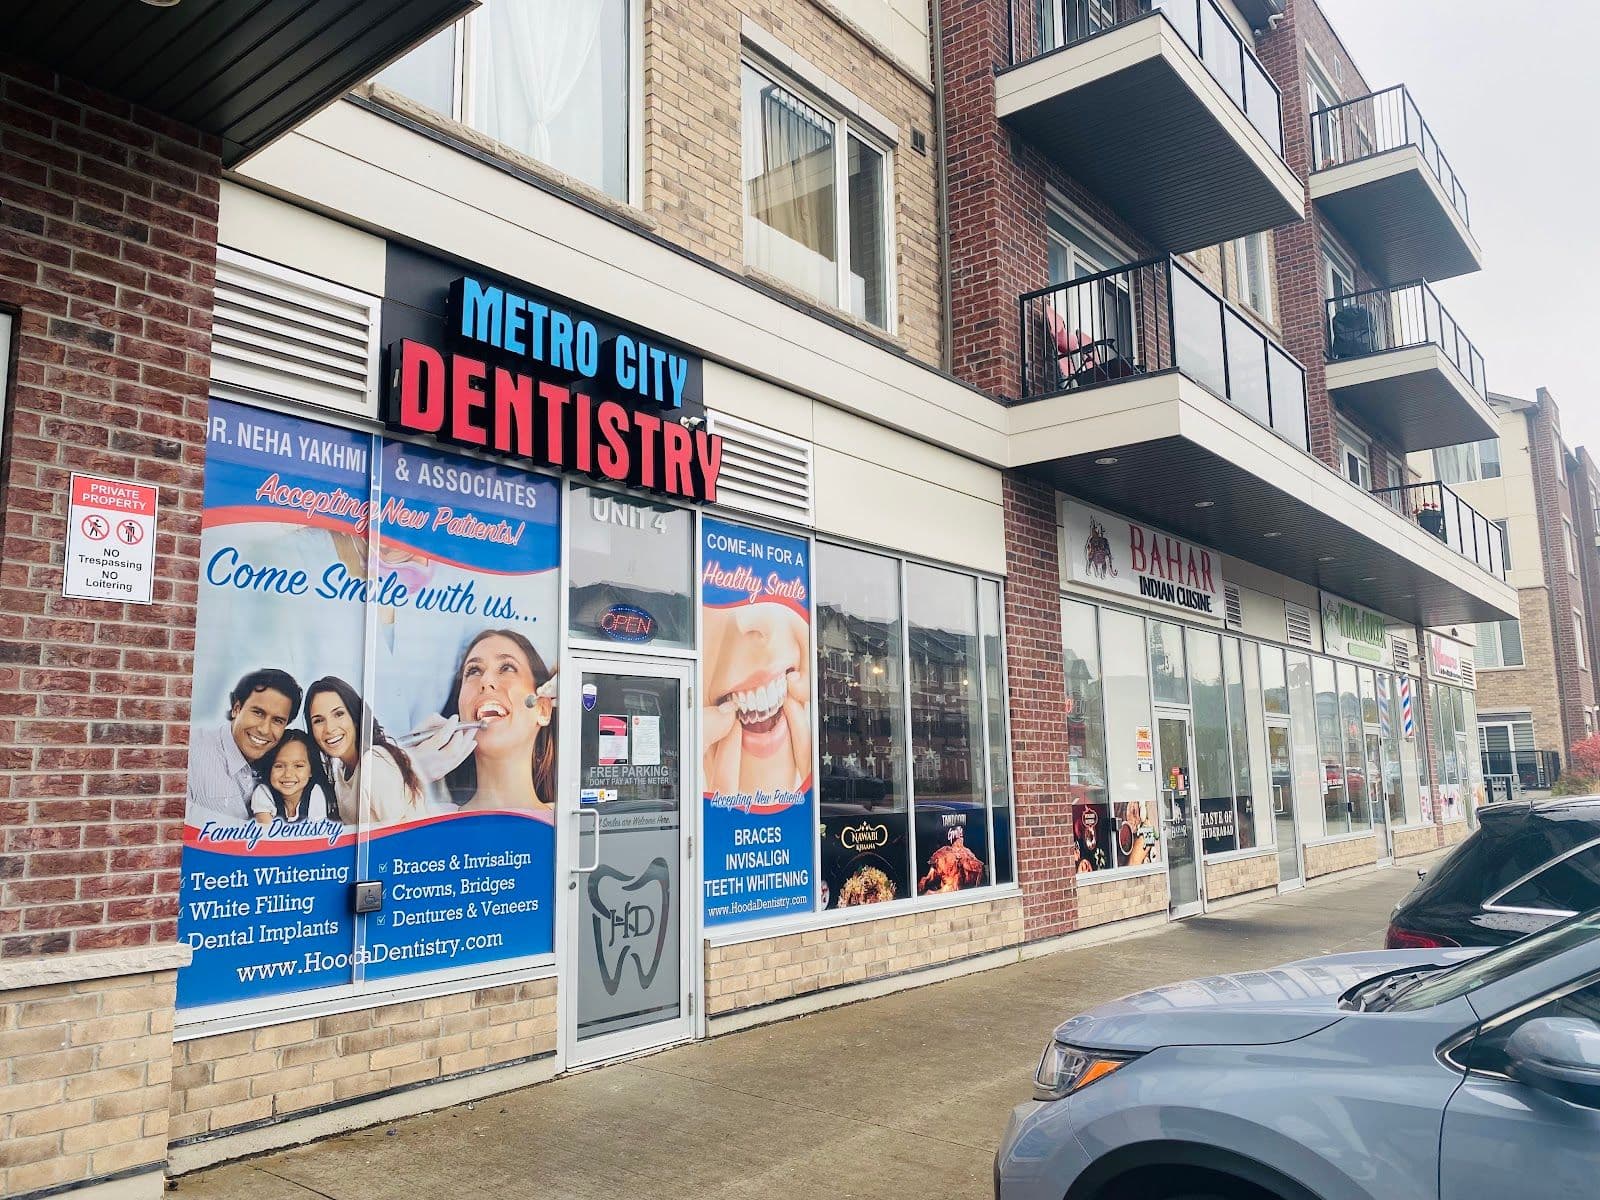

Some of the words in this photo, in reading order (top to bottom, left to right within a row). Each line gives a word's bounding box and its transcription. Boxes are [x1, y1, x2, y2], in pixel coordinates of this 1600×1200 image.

[461, 277, 598, 378] METRO
[615, 334, 688, 408] CITY
[400, 338, 723, 503] DENTISTRY
[207, 416, 233, 445] R.
[237, 422, 293, 457] NEHA
[299, 436, 367, 474] YAKHMI
[395, 457, 410, 482] &
[418, 463, 537, 508] ASSOCIATES
[82, 493, 147, 511] PROPERTY
[91, 484, 139, 498] PRIVATE
[256, 473, 377, 533] Accepting
[380, 497, 429, 529] New
[432, 506, 526, 546] Patients!
[592, 497, 651, 529] UNIT
[654, 512, 667, 534] 4
[78, 555, 142, 571] Trespassing
[103, 548, 120, 558] NO
[707, 533, 764, 559] COME-IN
[767, 546, 792, 565] FOR
[795, 552, 804, 567] A
[1128, 524, 1216, 593] BAHAR
[86, 578, 133, 592] Loitering
[102, 571, 118, 580] NO
[207, 547, 308, 596] Come
[315, 563, 409, 607] Smile
[416, 579, 477, 615] with
[483, 595, 538, 623] us...
[702, 560, 762, 603] Healthy
[764, 571, 806, 600] Smile
[1139, 575, 1175, 603] INDIAN
[1177, 586, 1212, 613] CUISINE
[601, 613, 651, 635] OPEN
[589, 778, 610, 786] DON'T
[648, 776, 669, 785] METER
[590, 767, 619, 777] FREE
[622, 766, 669, 777] PARKING
[710, 791, 752, 814] Accepting
[754, 790, 771, 805] New
[774, 789, 805, 806] Patients
[1200, 812, 1223, 826] TASTE
[1224, 811, 1233, 823] OF
[199, 819, 262, 850] Family
[267, 818, 343, 845] Dentistry
[734, 827, 782, 846] BRACES
[393, 857, 446, 875] Braces
[449, 856, 461, 870] &
[463, 851, 531, 871] Invisalign
[726, 849, 790, 870] INVISALIGN
[190, 869, 248, 891] Teeth
[254, 863, 349, 889] Whitening
[392, 882, 456, 901] Crowns,
[460, 876, 515, 895] Bridges
[704, 876, 743, 897] TEETH
[747, 870, 809, 892] WHITENING
[189, 896, 251, 921] White
[254, 893, 315, 916] Filling
[392, 907, 463, 927] Dentures
[466, 904, 478, 919] &
[481, 897, 539, 916] Veneers
[708, 894, 807, 918] www.HoodaDentistry.com
[187, 927, 254, 952] Dental
[258, 919, 339, 945] Implants
[237, 931, 504, 983] www.HoodaDentistry.com
